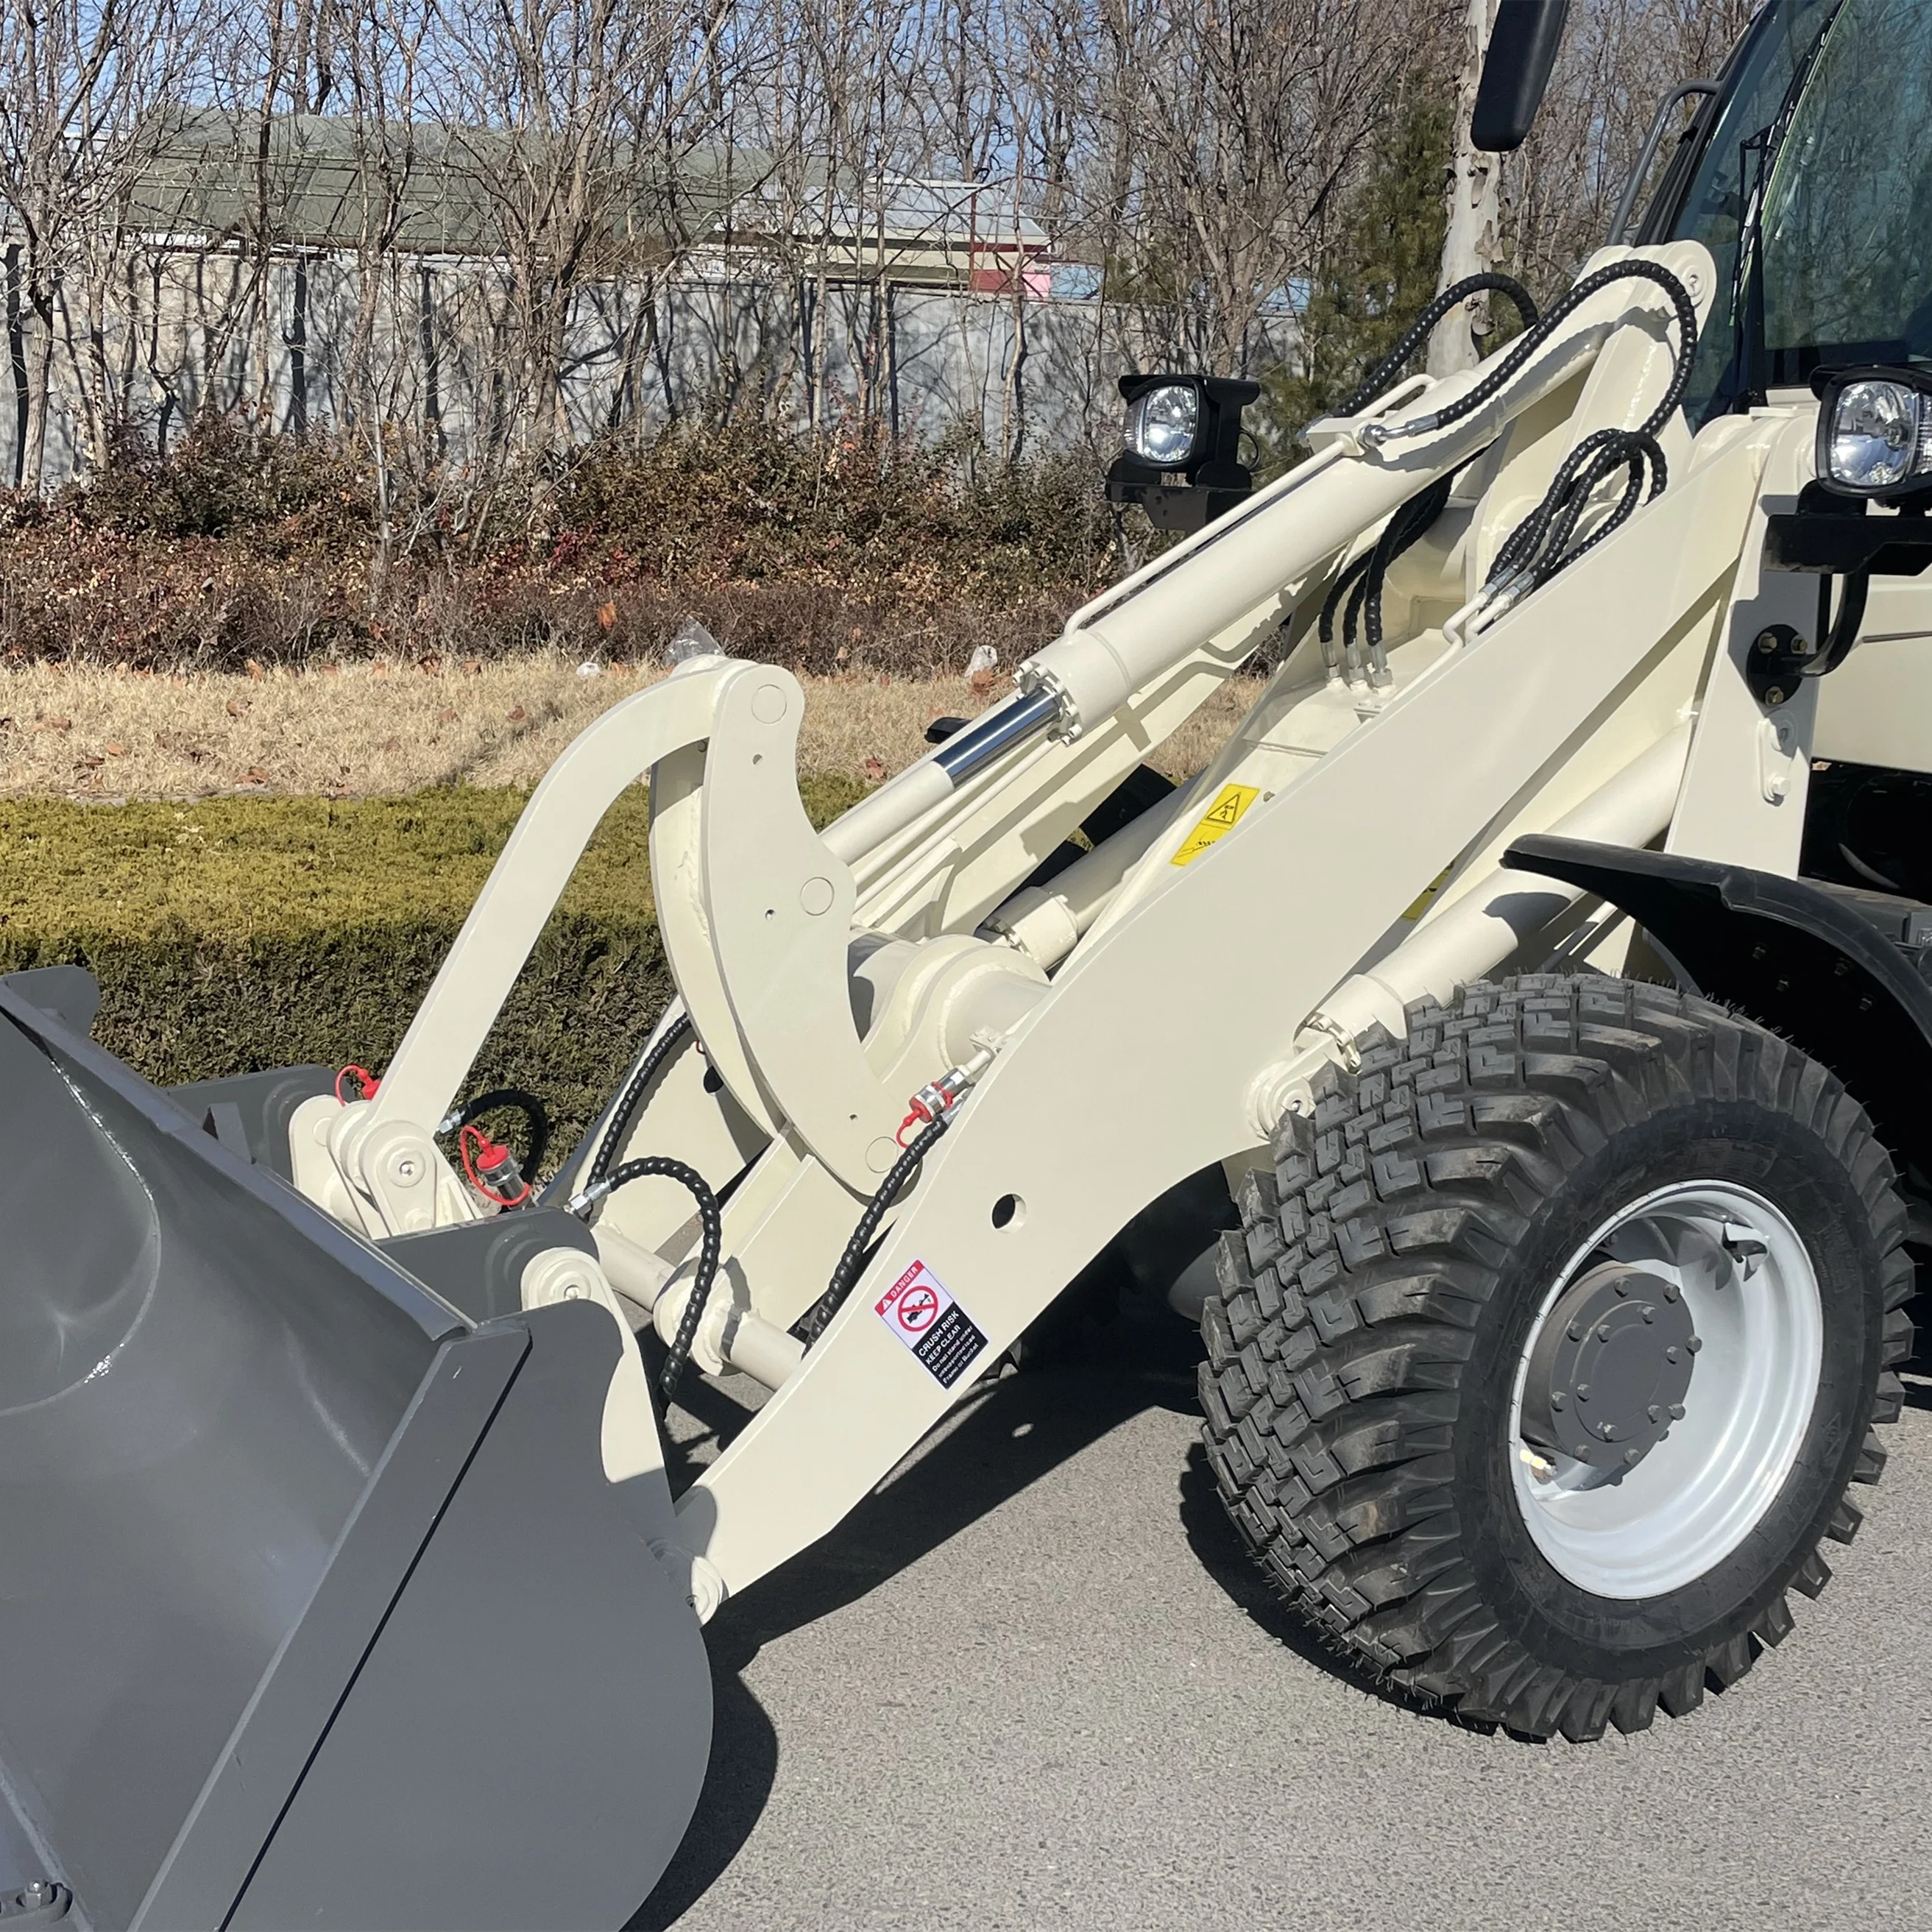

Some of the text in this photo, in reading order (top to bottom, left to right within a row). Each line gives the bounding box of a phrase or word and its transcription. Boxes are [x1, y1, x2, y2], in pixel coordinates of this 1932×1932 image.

[891, 1266, 918, 1298] DANGER
[918, 1311, 959, 1356] CRUSH RISK
[925, 1325, 961, 1365] KEEP CLEAR
[932, 1363, 941, 1372] Do
[948, 1340, 960, 1355] stand
[959, 1326, 973, 1342] under
